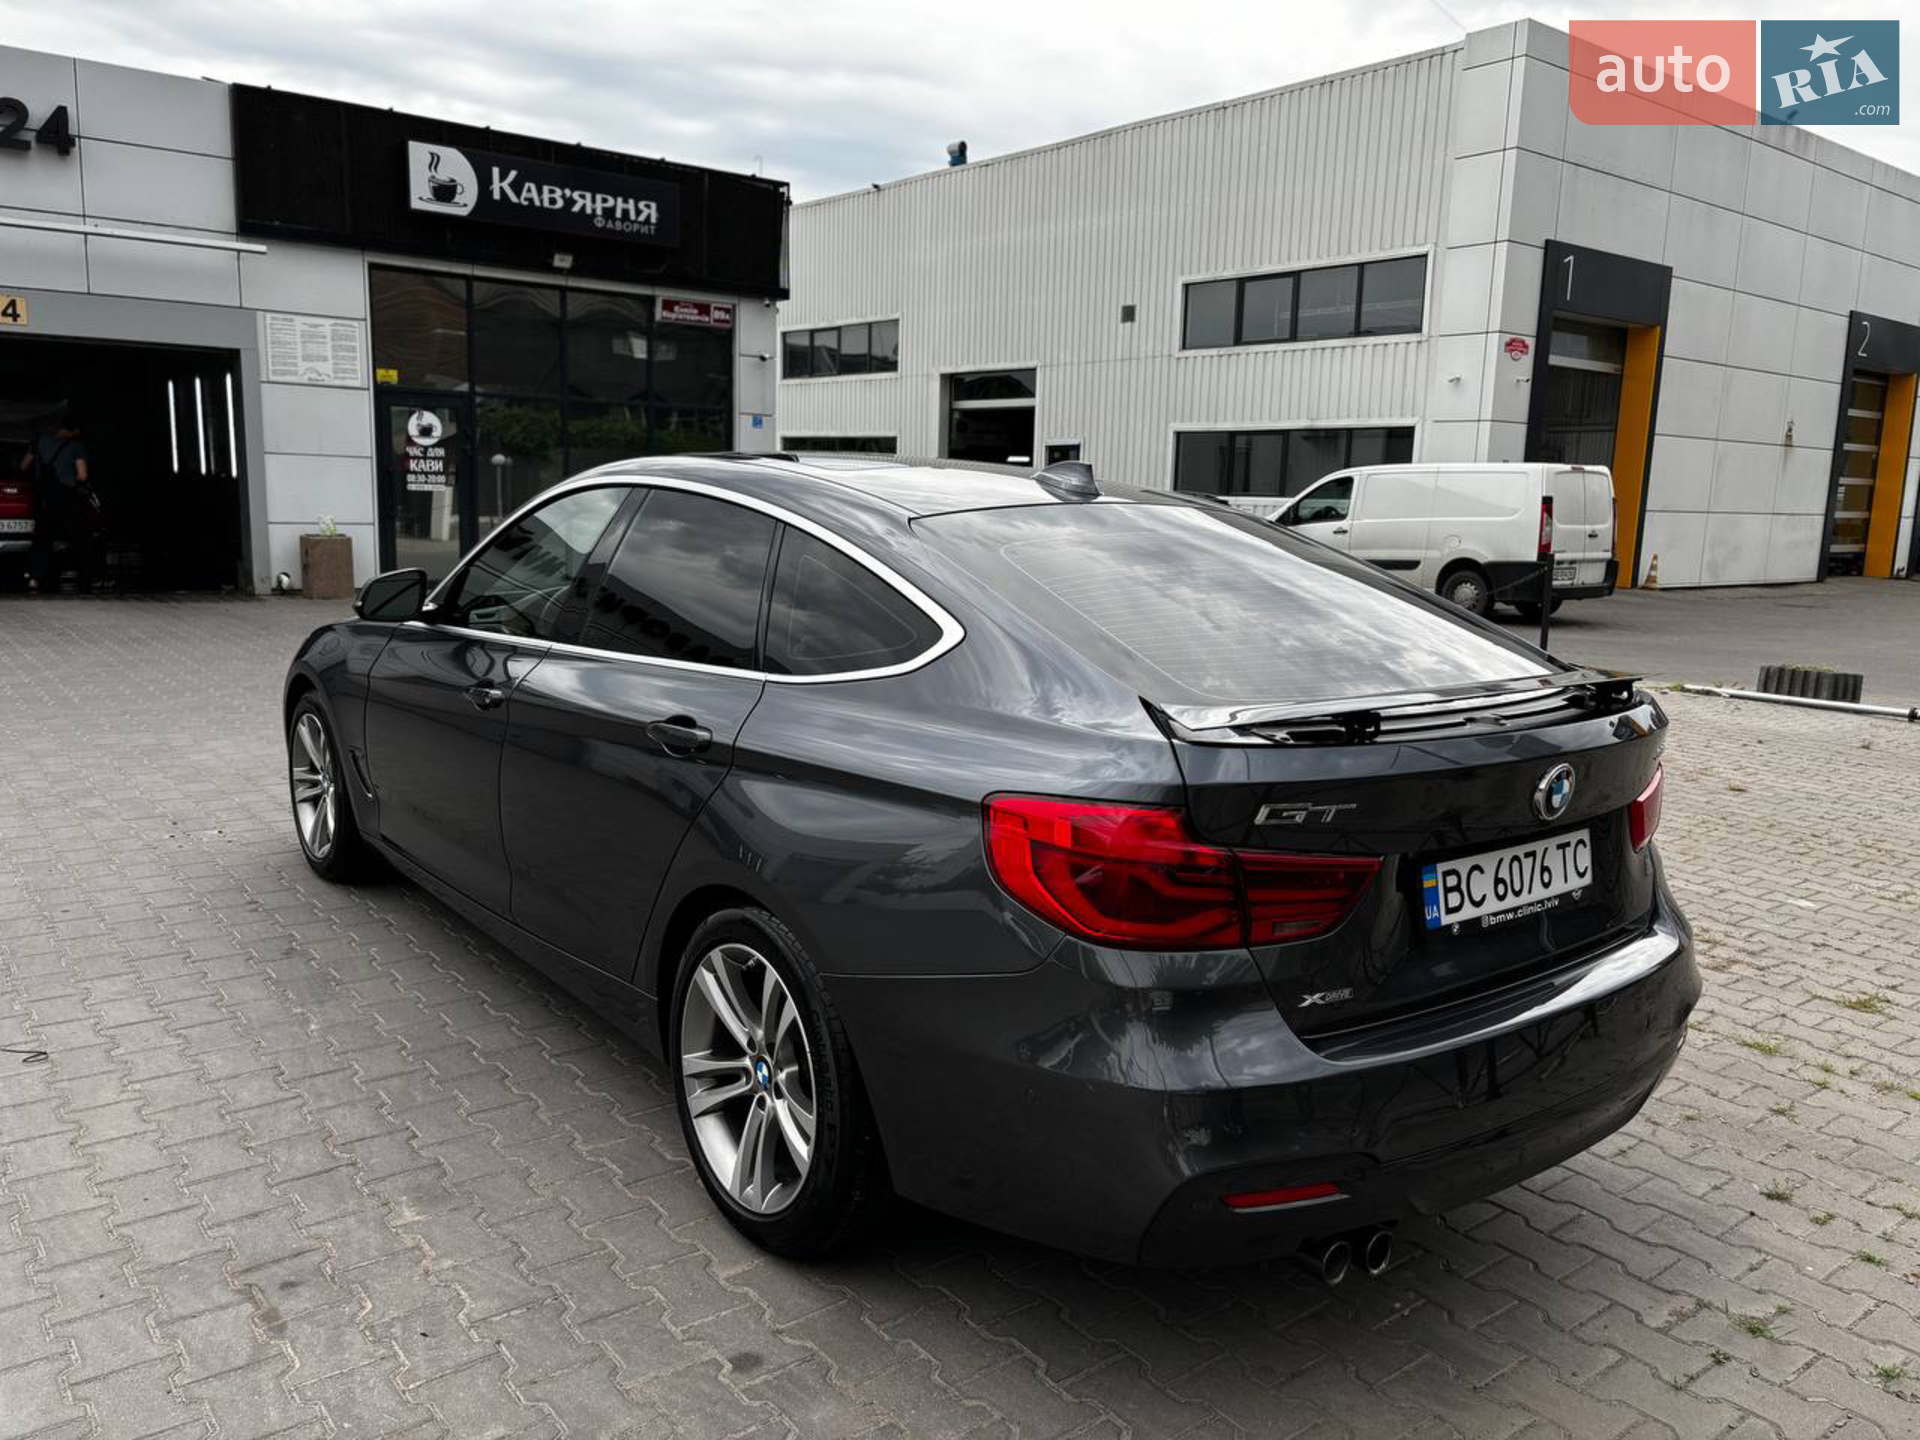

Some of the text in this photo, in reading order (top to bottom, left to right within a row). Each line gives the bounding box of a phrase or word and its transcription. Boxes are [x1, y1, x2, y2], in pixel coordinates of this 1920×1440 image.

[593, 215, 658, 236] ФАВОРИТ
[1563, 254, 1575, 301] 1
[1858, 321, 1871, 357] 2
[406, 446, 424, 458] ЧАС
[409, 459, 443, 473] КАВИ
[1254, 802, 1357, 825] GT
[1441, 838, 1589, 916] BC 6076 TC
[1424, 905, 1440, 920] UA
[1489, 898, 1560, 926] bmw.clinic.lviv
